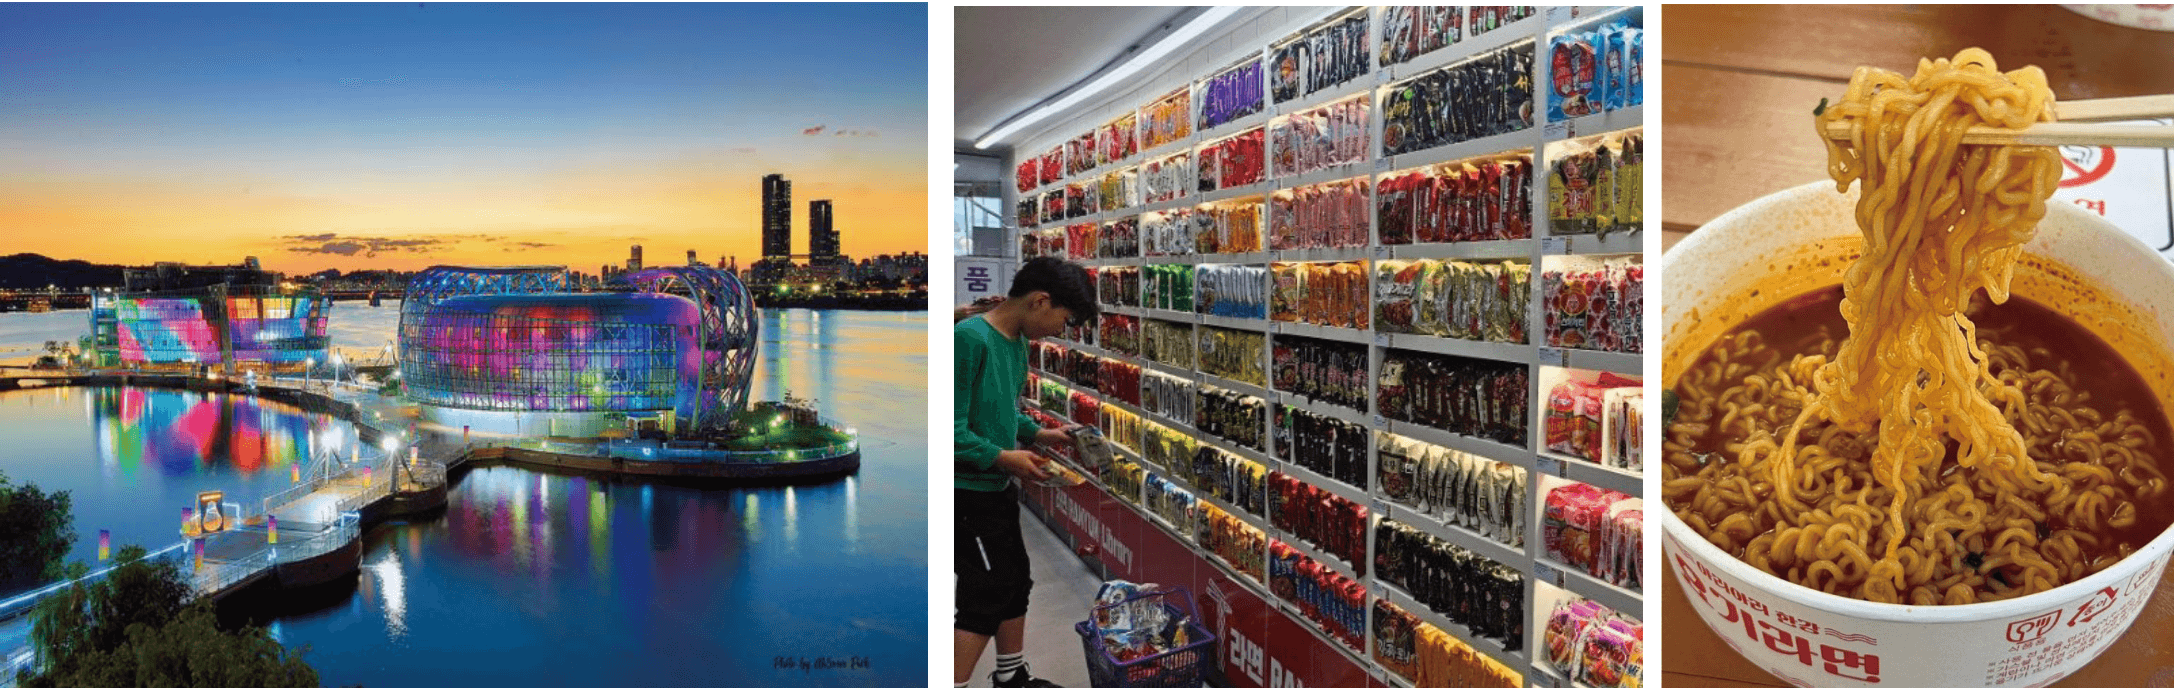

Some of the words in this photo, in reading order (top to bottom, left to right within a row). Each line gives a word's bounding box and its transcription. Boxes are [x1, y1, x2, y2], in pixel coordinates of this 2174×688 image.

[963, 266, 992, 292] 품
[1101, 523, 1133, 575] Library
[1696, 560, 1770, 617] 아리아리
[1775, 610, 1820, 635] 한강
[1230, 627, 1263, 687] 라면
